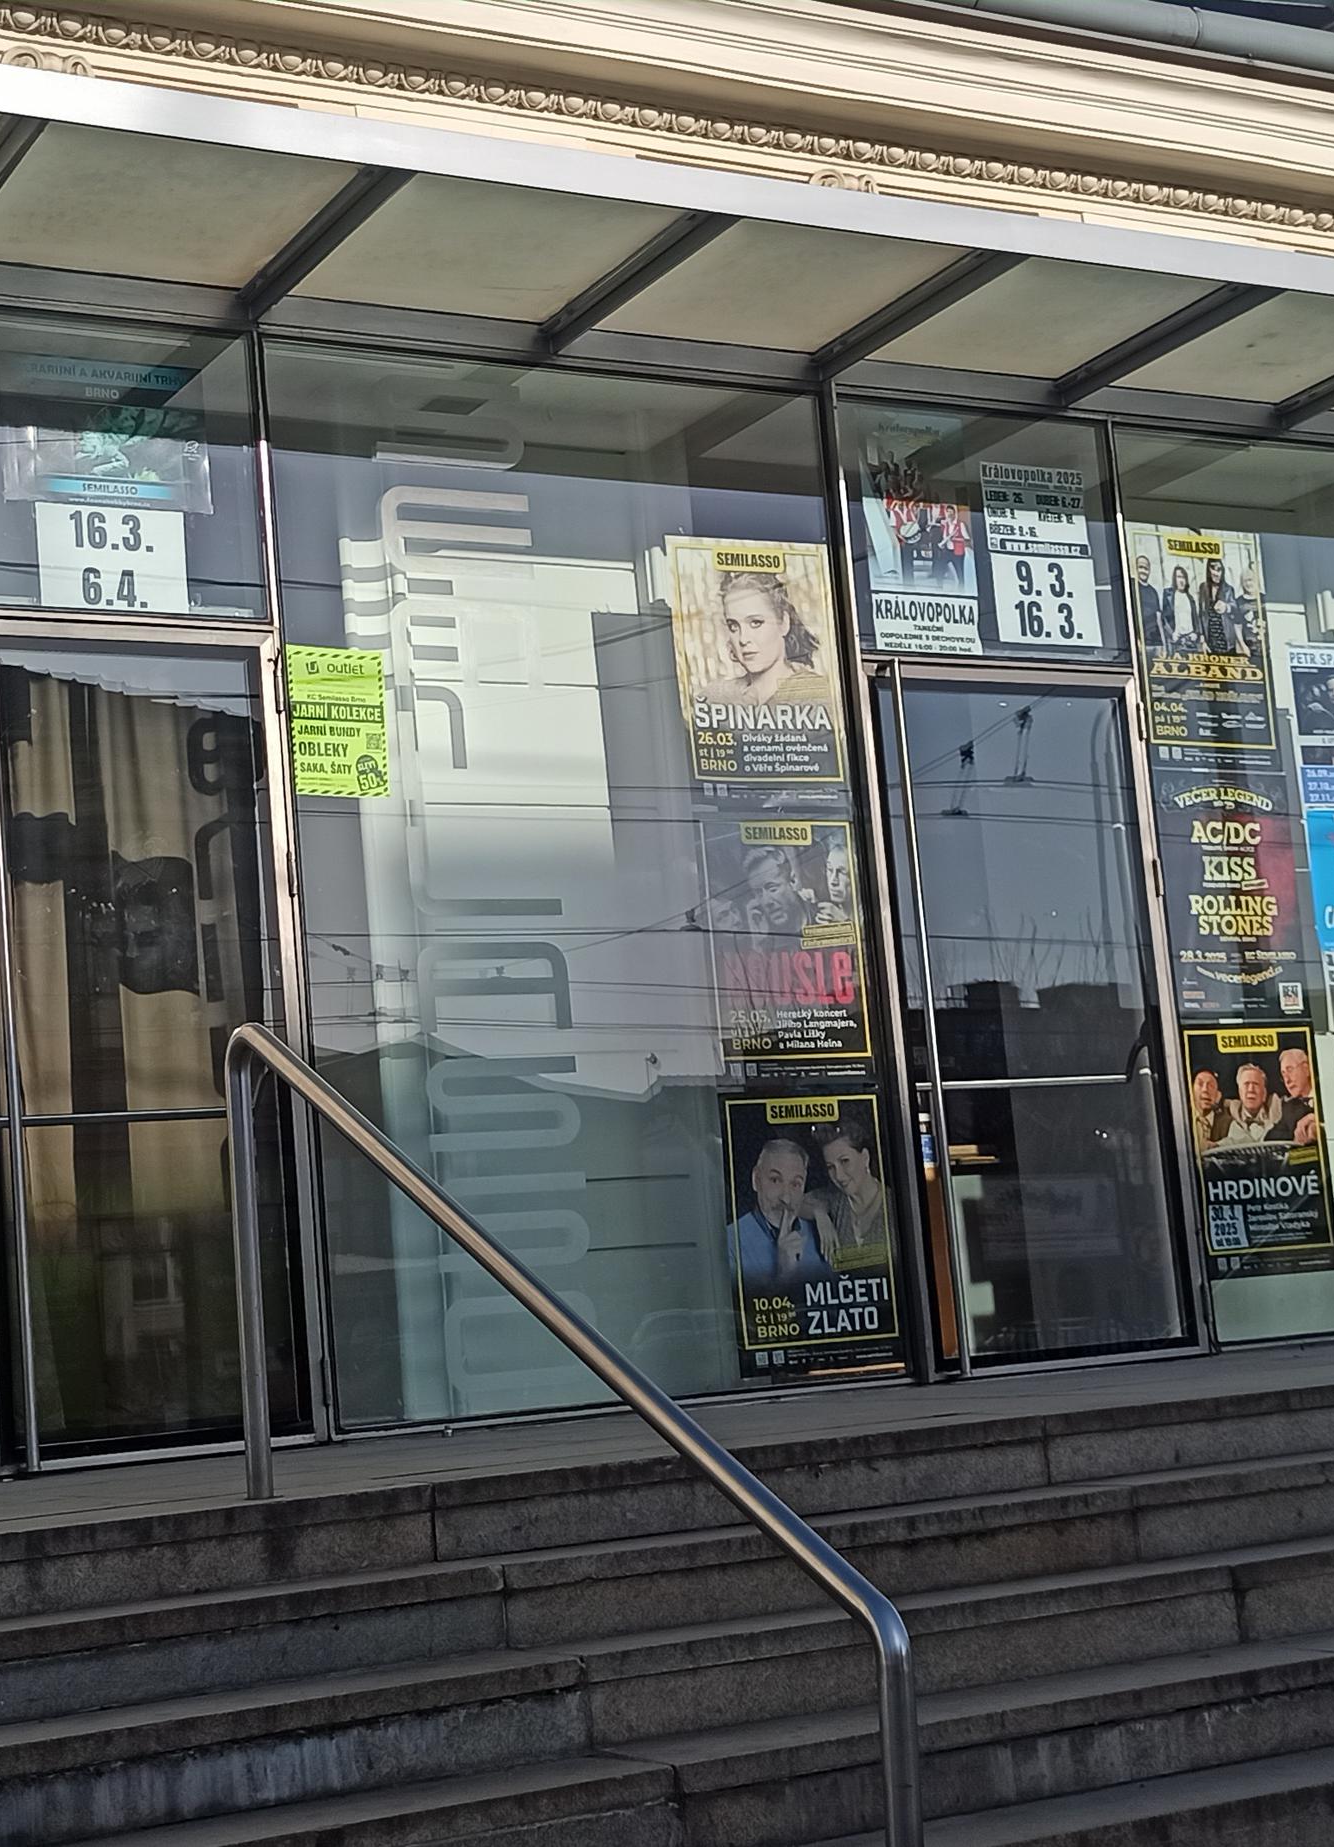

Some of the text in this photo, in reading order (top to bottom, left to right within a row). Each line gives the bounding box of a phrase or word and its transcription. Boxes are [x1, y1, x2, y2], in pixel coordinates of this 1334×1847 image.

[85, 386, 120, 399] BRNO
[981, 464, 1053, 484] Královopolka
[1056, 471, 1082, 486] 2025
[82, 483, 138, 495] SEMILASSO
[69, 510, 154, 553] 16.3.
[1166, 538, 1221, 556] SEMILASSO
[716, 551, 781, 569] SEMILASSO
[1016, 560, 1074, 599] 9. 3.
[82, 567, 148, 609] 6.4.
[875, 597, 975, 626] KRÁLOVOPOLKA
[1015, 601, 1084, 640] 16. 3.
[1289, 652, 1317, 665] PETR
[1150, 661, 1265, 681] ALBAND
[293, 701, 382, 721] JARNÍ KOLEKCE
[694, 696, 833, 730] ŠPINARKA
[297, 723, 361, 738] JARNÍ BUNDY
[742, 733, 807, 744] Diváky žádaná
[1156, 725, 1188, 737] BRNO
[697, 731, 738, 747] 26.03.
[298, 741, 349, 758] OBLEKY
[750, 743, 784, 752] cenami
[785, 743, 829, 753] ověnčená
[701, 758, 738, 772] BRNO
[743, 753, 810, 763] divadelní fikce
[300, 761, 353, 775] SAKA, ŠATY
[774, 762, 820, 773] Špinarové
[1173, 786, 1219, 809] VEČER
[1219, 787, 1273, 812] LEGEND
[744, 826, 809, 842] SEMILASSO
[1190, 820, 1262, 846] AC/DC
[1202, 856, 1258, 882] KISS
[1188, 894, 1279, 916] ROLLING
[1198, 915, 1274, 936] STONES
[813, 1008, 848, 1018] koncert
[803, 1018, 858, 1030] Langmajera,
[777, 1030, 802, 1039] Pavla
[1220, 1033, 1275, 1049] SEMILASSO
[732, 1037, 773, 1051] BRNO
[786, 1039, 816, 1049] Milana
[770, 1102, 836, 1120] SEMILASSO
[1208, 1169, 1321, 1202] HRDINOVÉ
[1214, 1222, 1238, 1237] 2025
[753, 1274, 889, 1311] 10.04. MLČETI
[755, 1313, 768, 1325] čt
[758, 1306, 879, 1339] BRNO ZLATO
